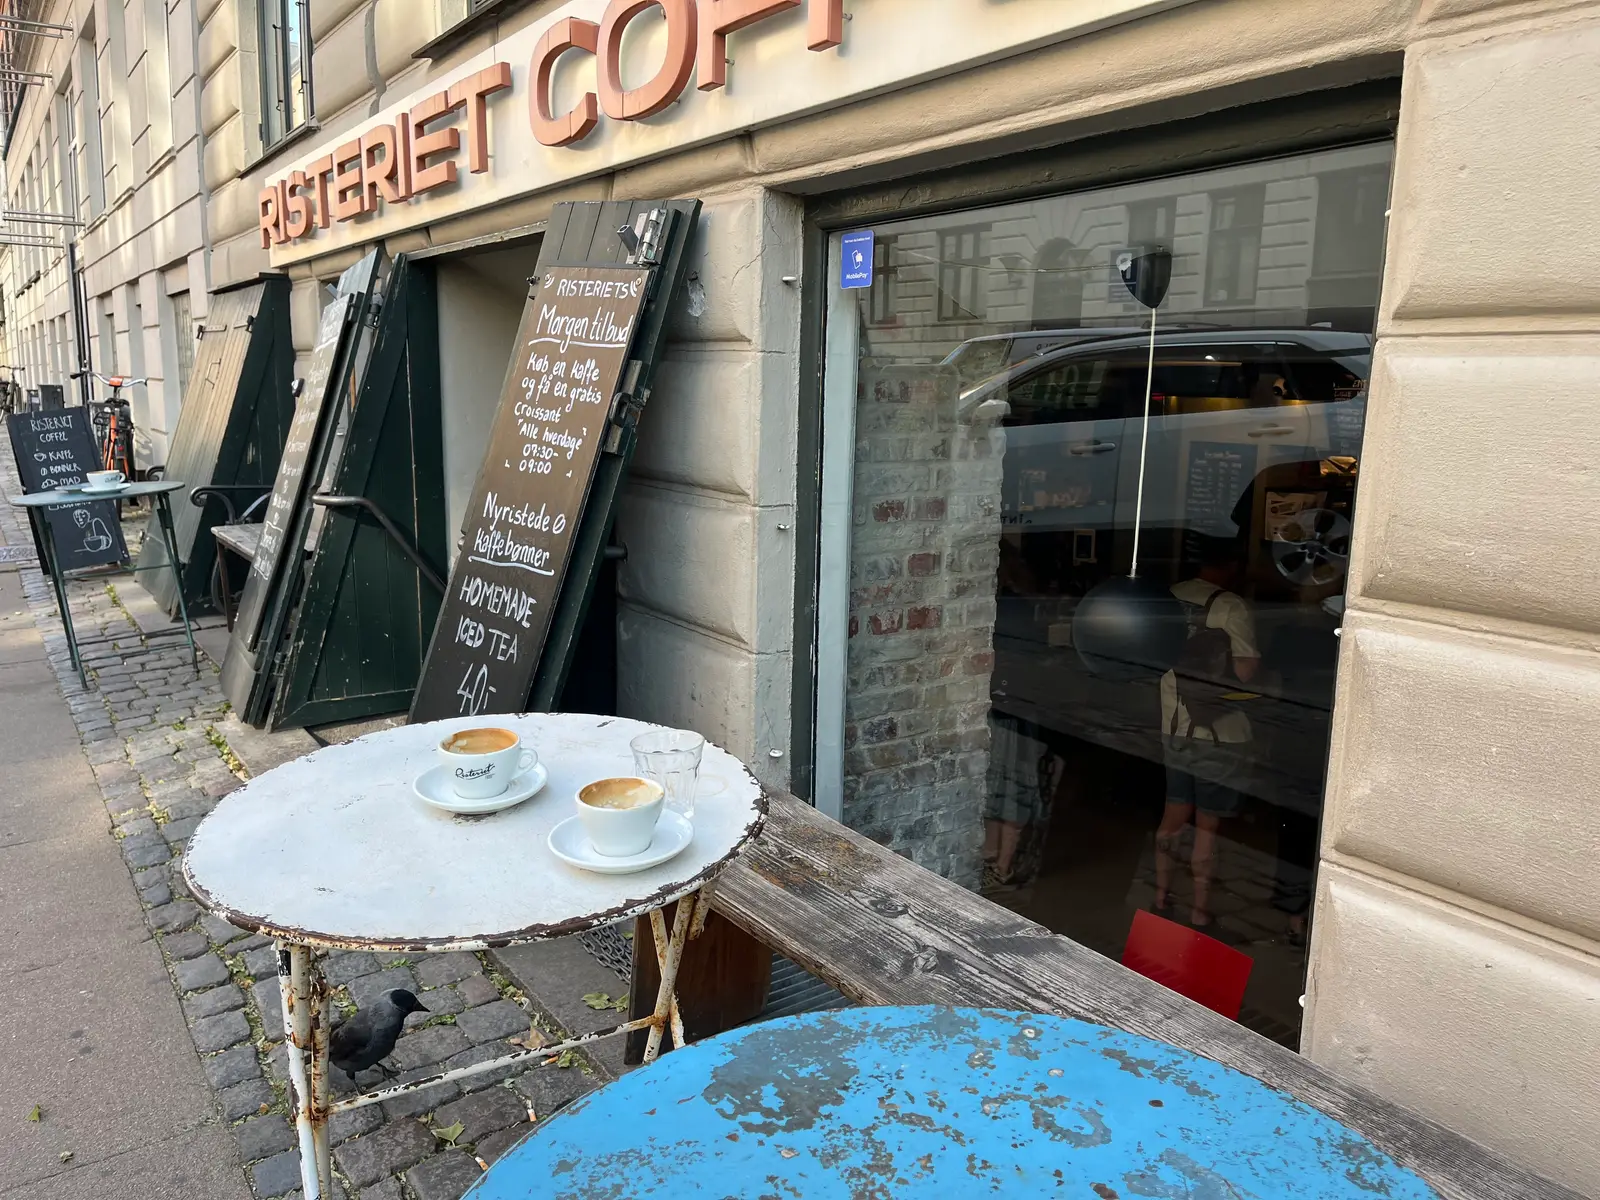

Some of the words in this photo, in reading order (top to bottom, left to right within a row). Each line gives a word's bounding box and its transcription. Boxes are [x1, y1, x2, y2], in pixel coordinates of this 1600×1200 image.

[259, 62, 511, 249] RISTERIET
[557, 279, 629, 298] RISTERIETS
[536, 304, 588, 353] Morgen
[589, 307, 634, 342] tilbud
[527, 352, 549, 373] Køb
[552, 361, 566, 378] en
[522, 377, 536, 400] og
[536, 373, 553, 402] få
[554, 381, 568, 397] en
[565, 386, 602, 412] gratis
[40, 431, 68, 443] COFFEE
[60, 476, 81, 486] MAD
[519, 459, 552, 474] 09:00
[483, 491, 550, 532] Nyristede
[459, 575, 537, 629] HOMEMADE
[455, 614, 485, 648] ICED
[488, 628, 518, 664] TEA
